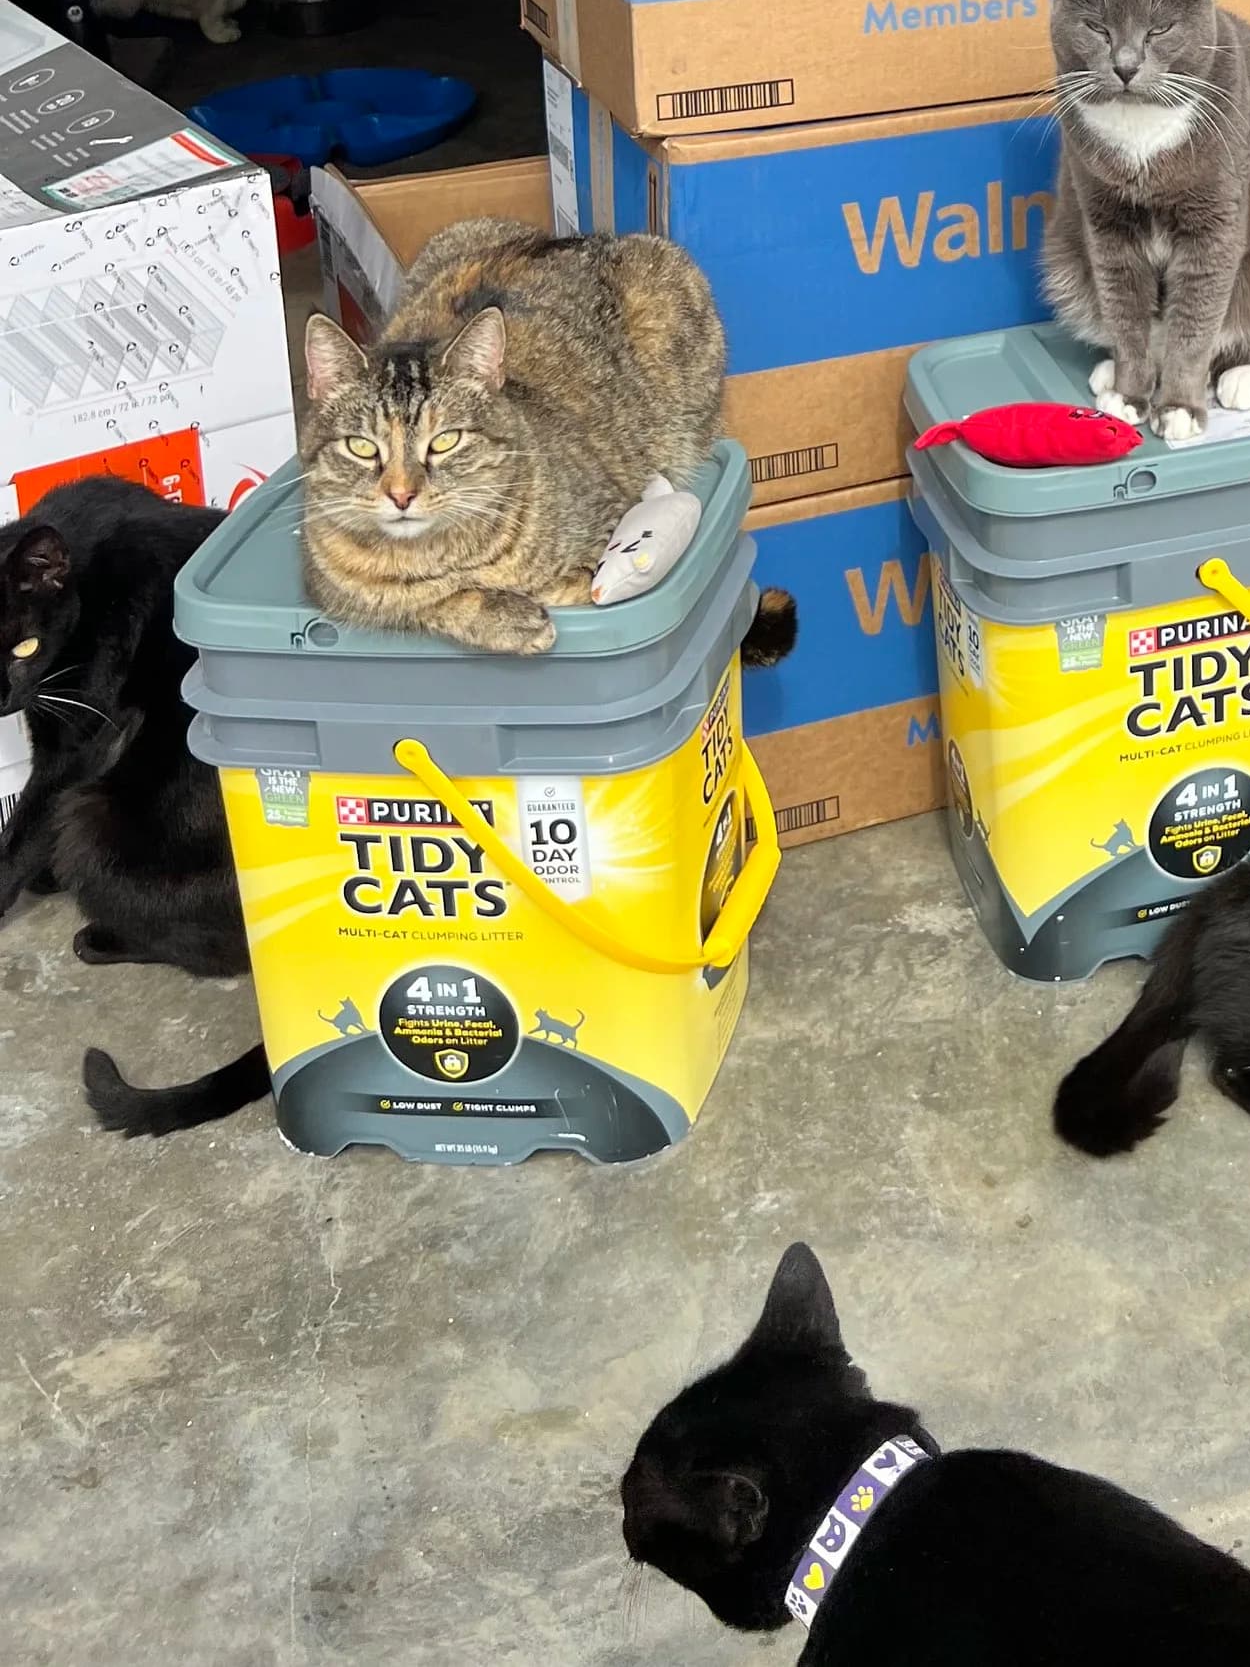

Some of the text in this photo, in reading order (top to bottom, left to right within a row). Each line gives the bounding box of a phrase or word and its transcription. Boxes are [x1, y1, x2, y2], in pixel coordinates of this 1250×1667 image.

[702, 707, 730, 768] TIDY
[1120, 744, 1182, 762] MULTI-CAT
[1184, 732, 1241, 752] CLUMPING
[703, 729, 734, 804] CATS
[1176, 774, 1239, 807] 4 IN 1
[527, 802, 576, 813] GUARANTEED
[1174, 799, 1242, 822] STRENGTH
[530, 818, 577, 846] 10
[340, 833, 487, 874] TIDY
[532, 848, 578, 863] DAY
[533, 865, 579, 875] ODOR
[343, 876, 507, 918] CATS
[1149, 905, 1169, 916] LOW
[338, 927, 524, 942] MULTI-CAT CLUMPING LITTER
[406, 976, 482, 1005] 4 IN 1
[407, 1005, 486, 1017] STRENGTH
[398, 1018, 430, 1029] Fights
[411, 1036, 443, 1045] Odors
[416, 1102, 442, 1110] DUST
[464, 1103, 537, 1112] TIGHT CLUMPS
